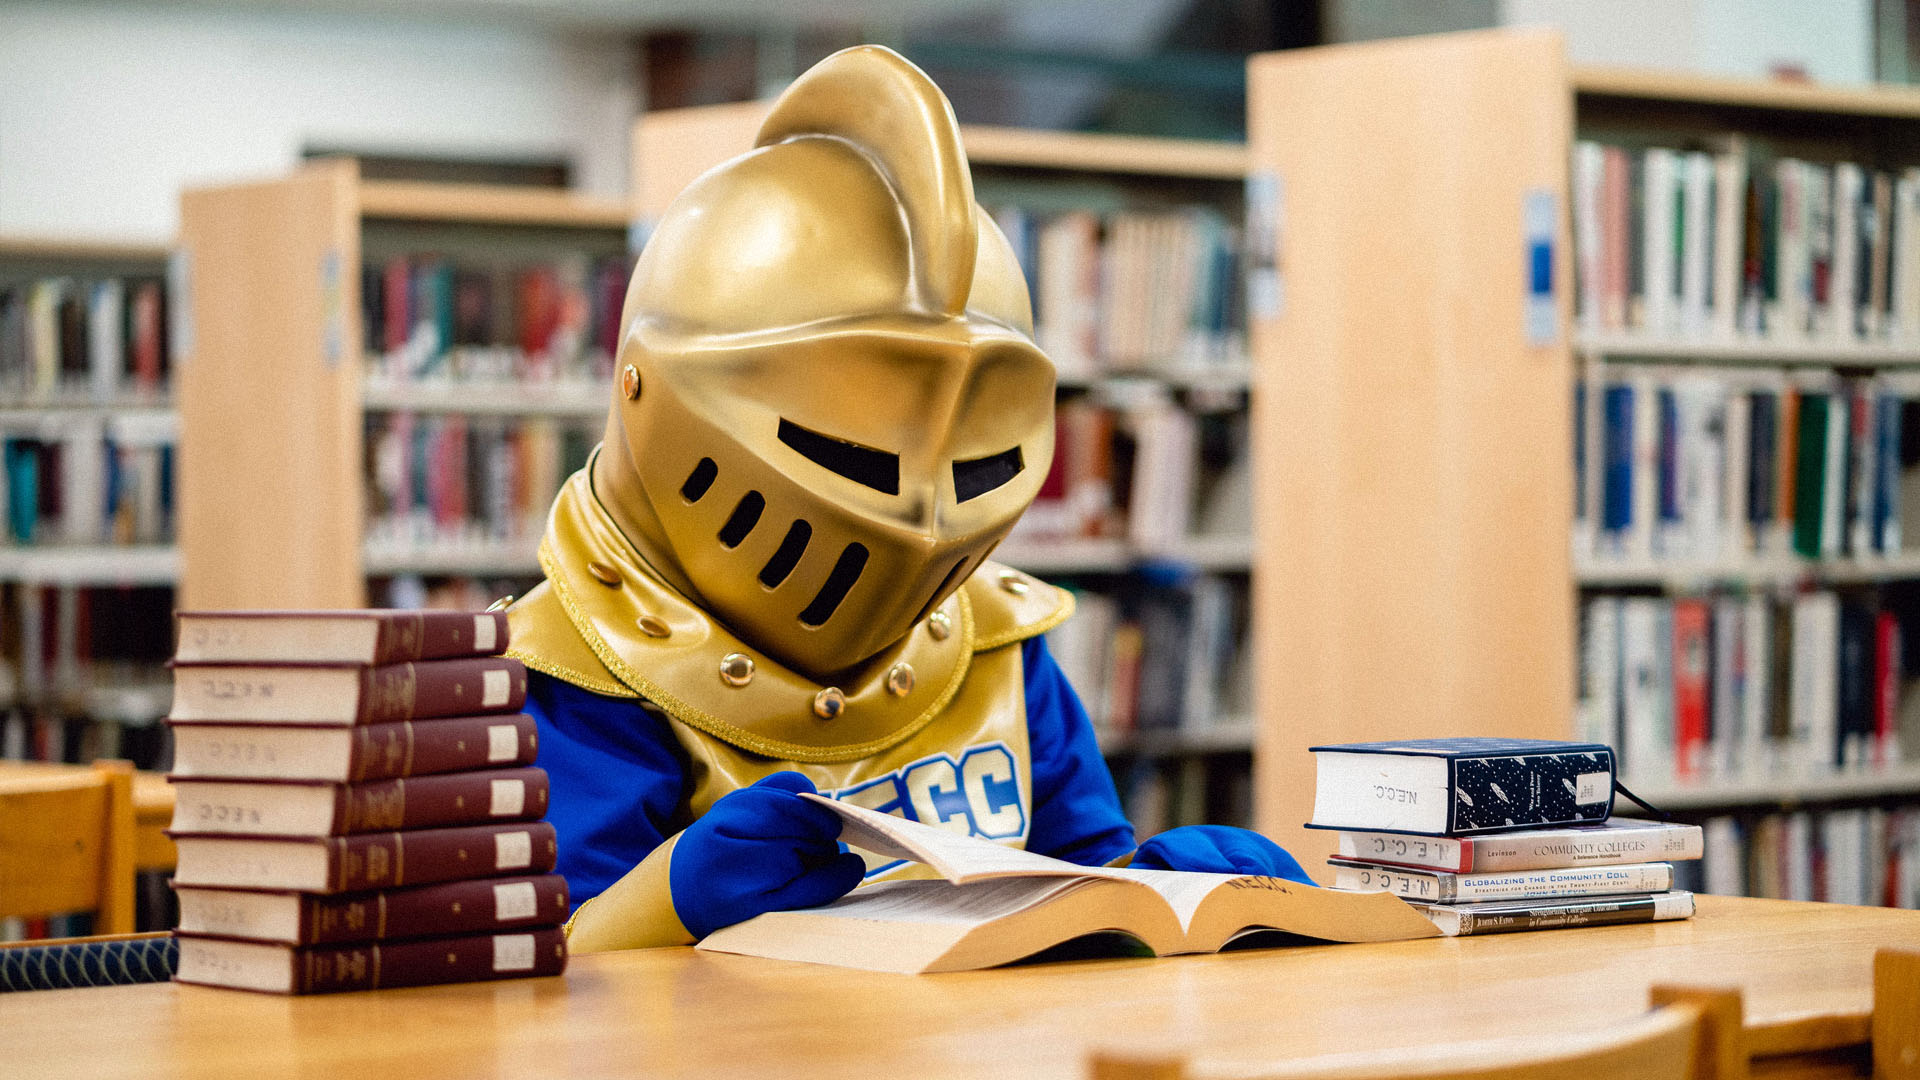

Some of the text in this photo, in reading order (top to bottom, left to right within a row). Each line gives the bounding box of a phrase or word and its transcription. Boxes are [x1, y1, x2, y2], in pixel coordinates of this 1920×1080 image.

[1373, 785, 1417, 805] N.E.C.C.
[815, 740, 1031, 879] ECC
[1487, 849, 1517, 857] Levinson
[1534, 840, 1646, 856] COMMUNITY COLLEGES
[1464, 877, 1525, 887] GLOBALIZING
[1550, 873, 1603, 883] COMMUNITY
